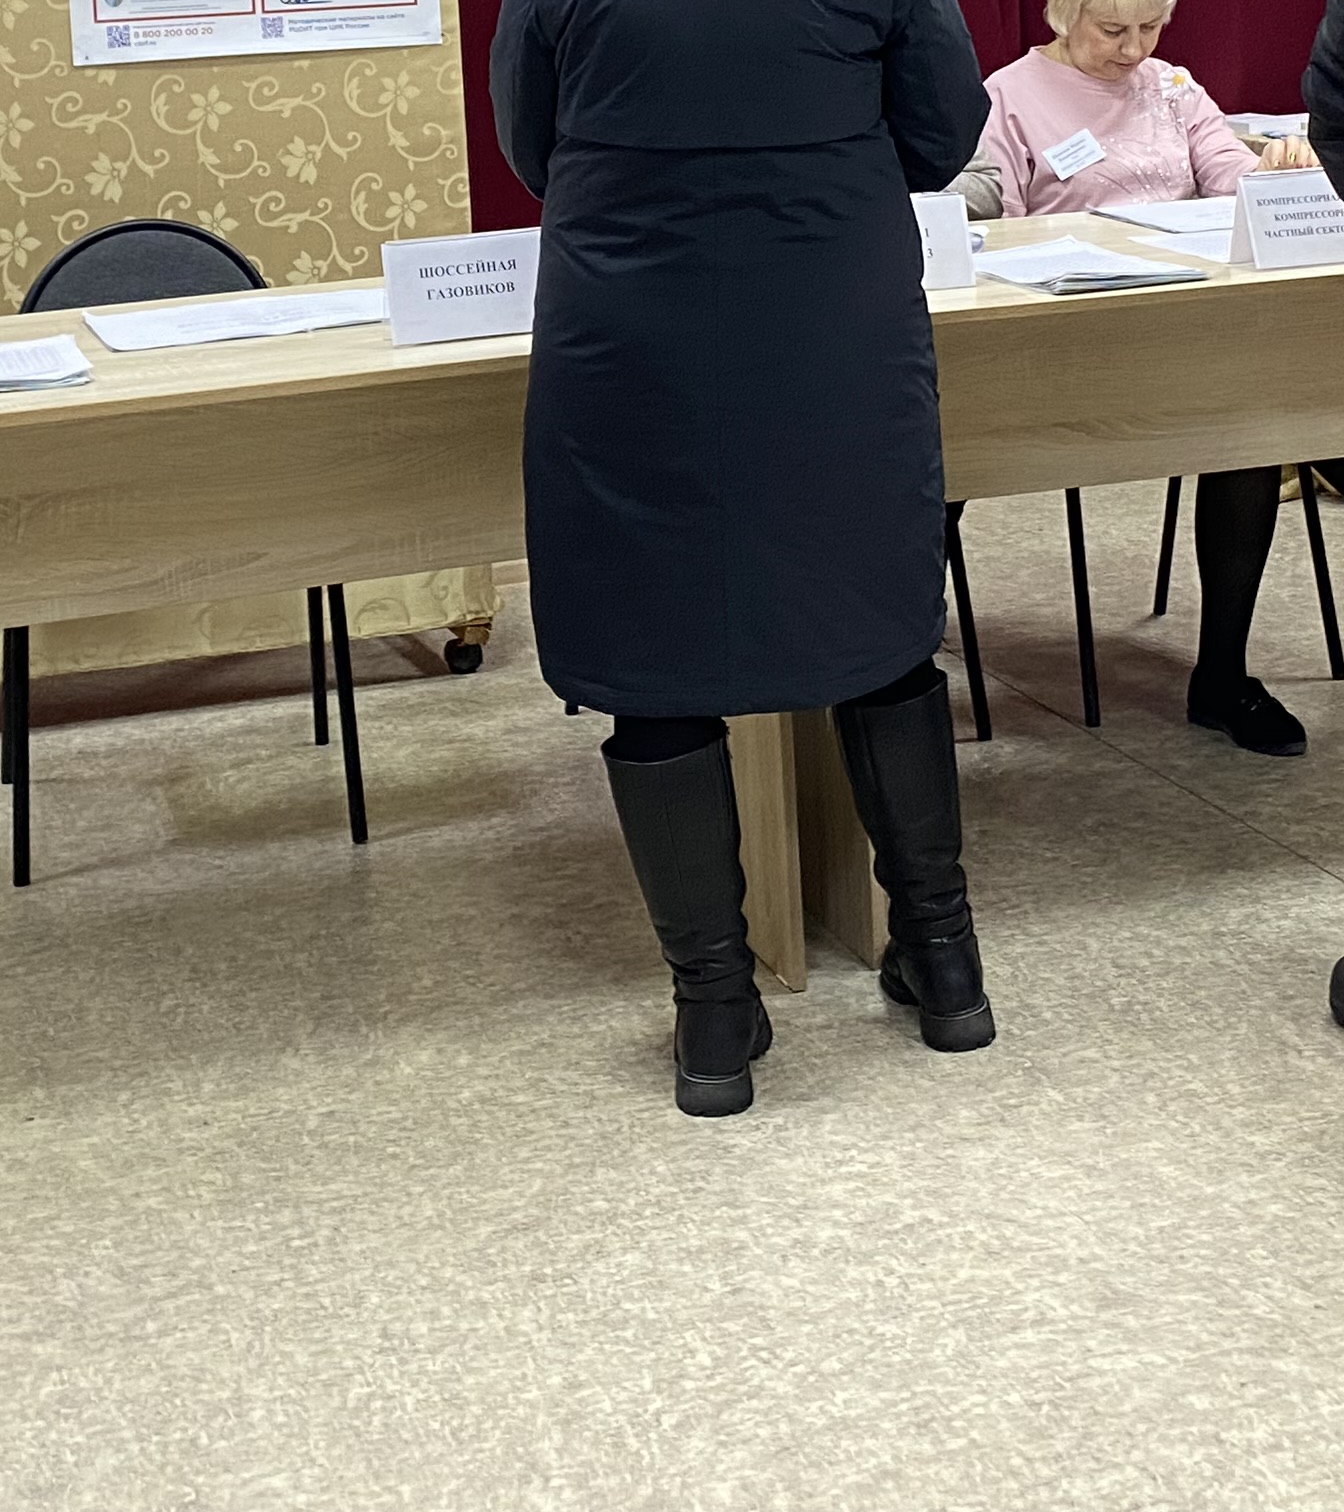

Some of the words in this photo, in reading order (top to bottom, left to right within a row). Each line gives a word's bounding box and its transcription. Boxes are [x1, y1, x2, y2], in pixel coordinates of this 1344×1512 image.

[142, 30, 161, 38] 800
[163, 28, 183, 37] 200
[185, 27, 199, 36] 00
[201, 26, 214, 35] 20
[1256, 193, 1340, 207] КОМПРЕССОРНА
[1264, 225, 1314, 238] ЧАСТНЫЙ
[419, 259, 517, 279] ШОССЕЙНАЯ
[427, 281, 516, 300] ГАЗОВИКОВ
